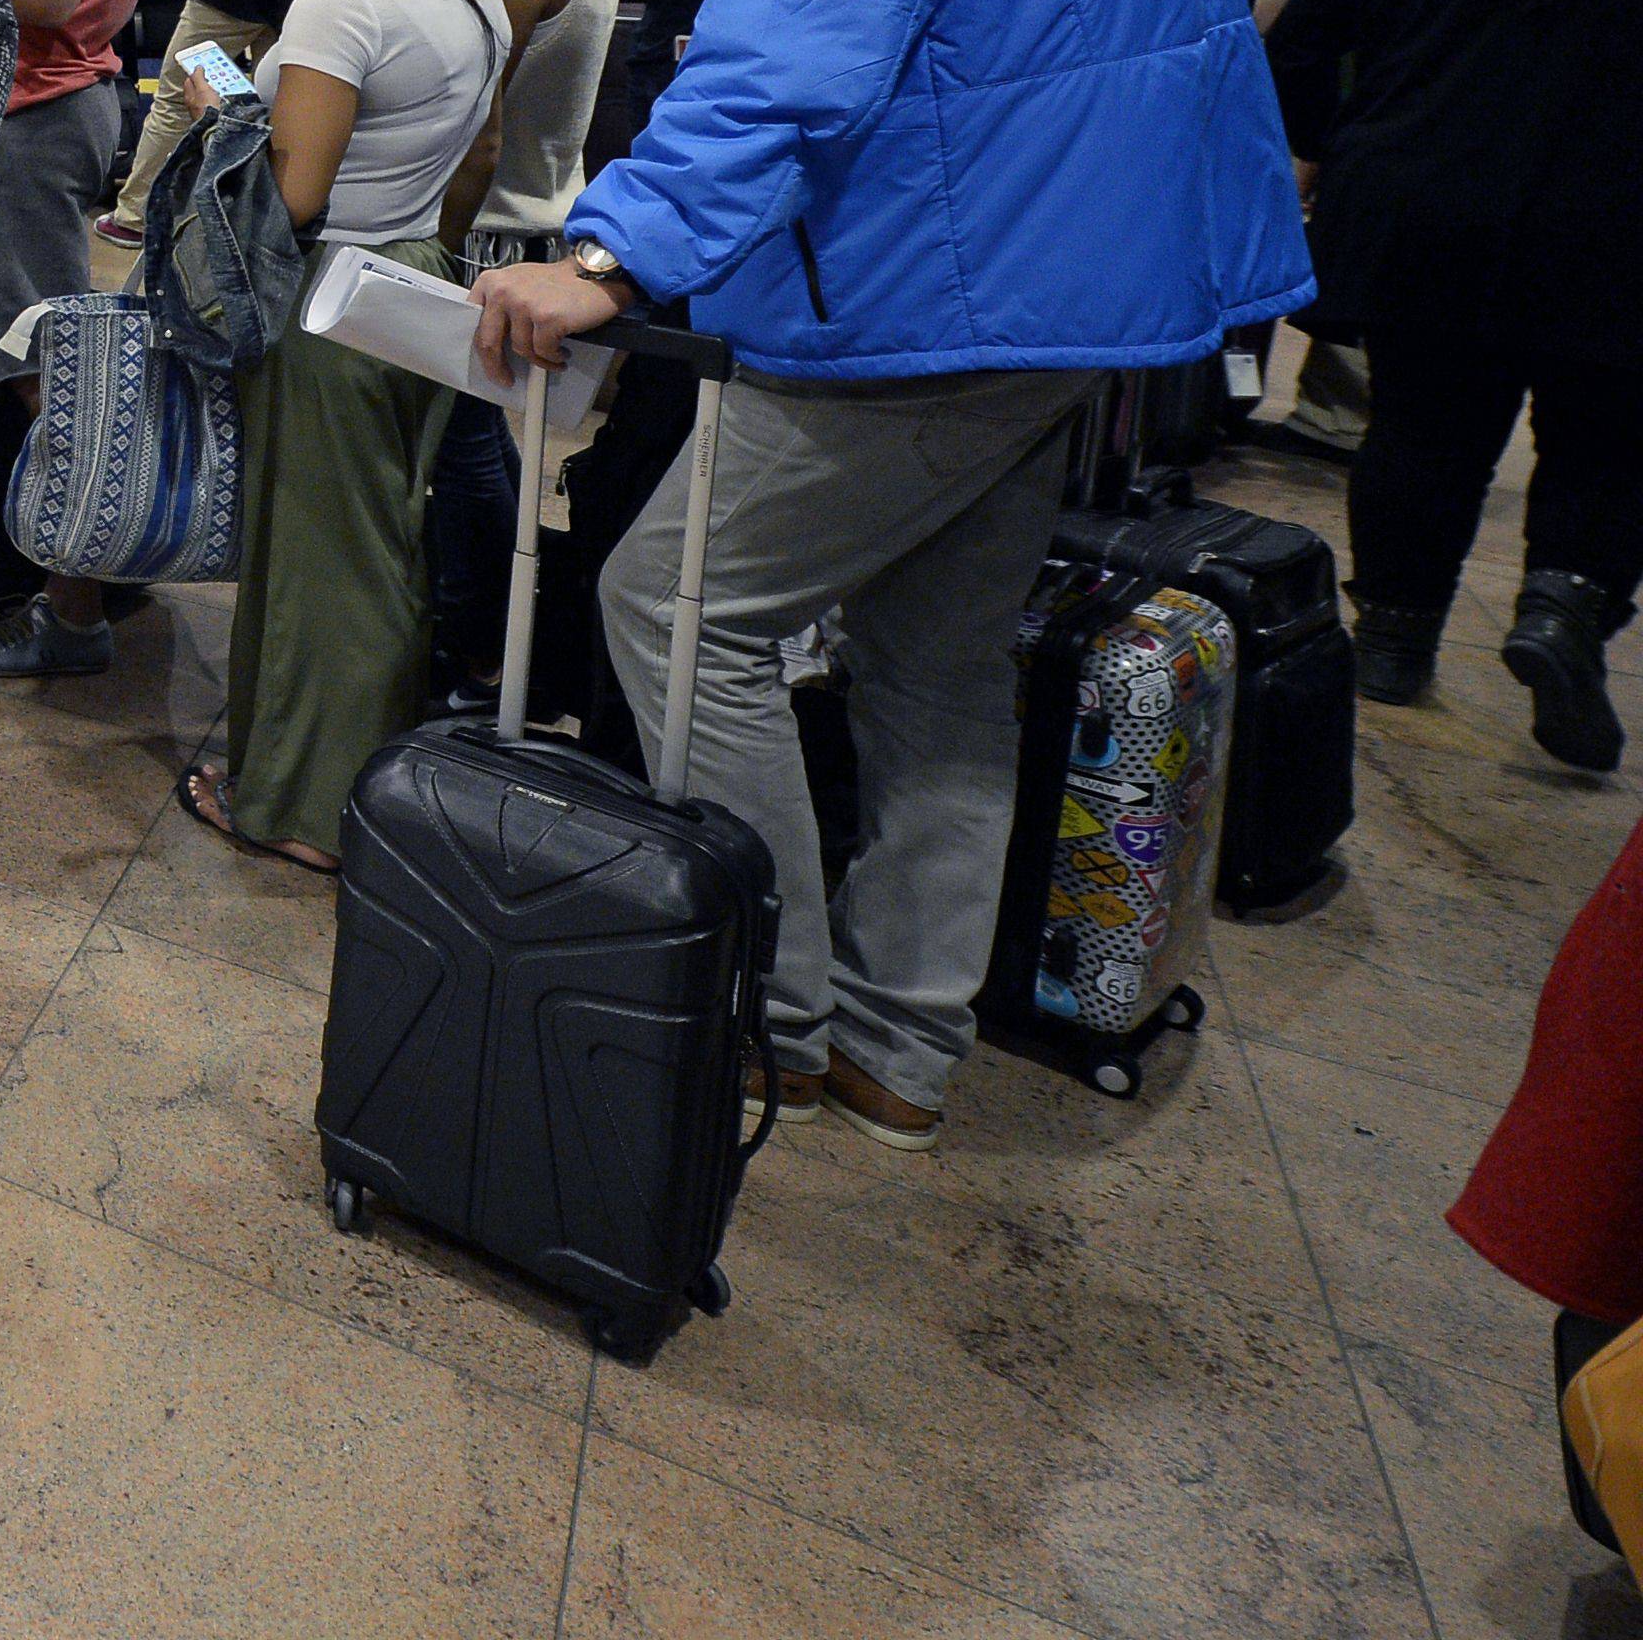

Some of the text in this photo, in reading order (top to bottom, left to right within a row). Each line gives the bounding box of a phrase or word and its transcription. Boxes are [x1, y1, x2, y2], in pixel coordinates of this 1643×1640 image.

[1138, 691, 1167, 714] 66
[1125, 828, 1168, 851] 95
[1107, 978, 1136, 1000] 66
